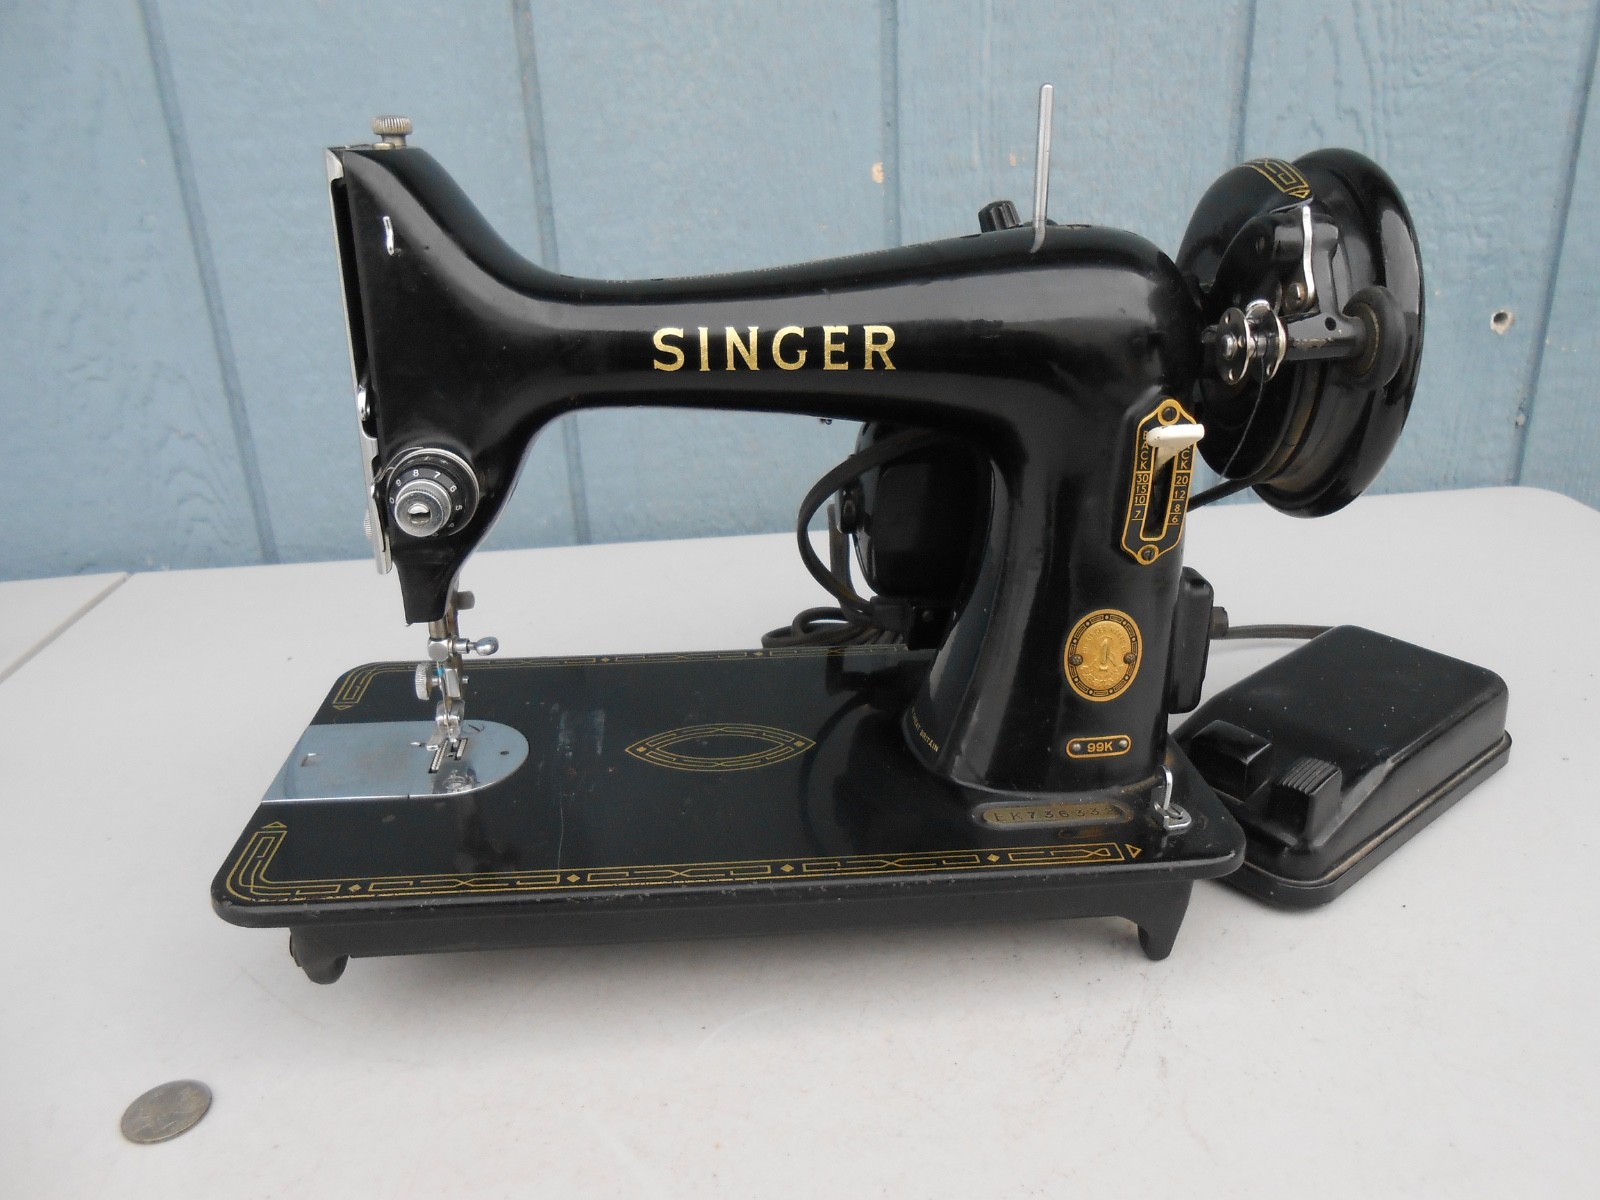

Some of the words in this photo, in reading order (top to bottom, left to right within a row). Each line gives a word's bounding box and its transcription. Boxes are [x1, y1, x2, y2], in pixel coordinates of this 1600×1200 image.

[652, 325, 897, 372] SINGER
[412, 469, 420, 477] 8
[434, 471, 441, 479] 7
[1136, 474, 1149, 484] 30
[1176, 475, 1189, 485] 20
[1136, 485, 1147, 494] 15
[1174, 490, 1186, 499] 12
[1134, 495, 1146, 504] 10
[1174, 503, 1181, 512] 8
[1134, 510, 1141, 519] 7
[1171, 515, 1178, 523] 6
[1087, 741, 1113, 752] 99K
